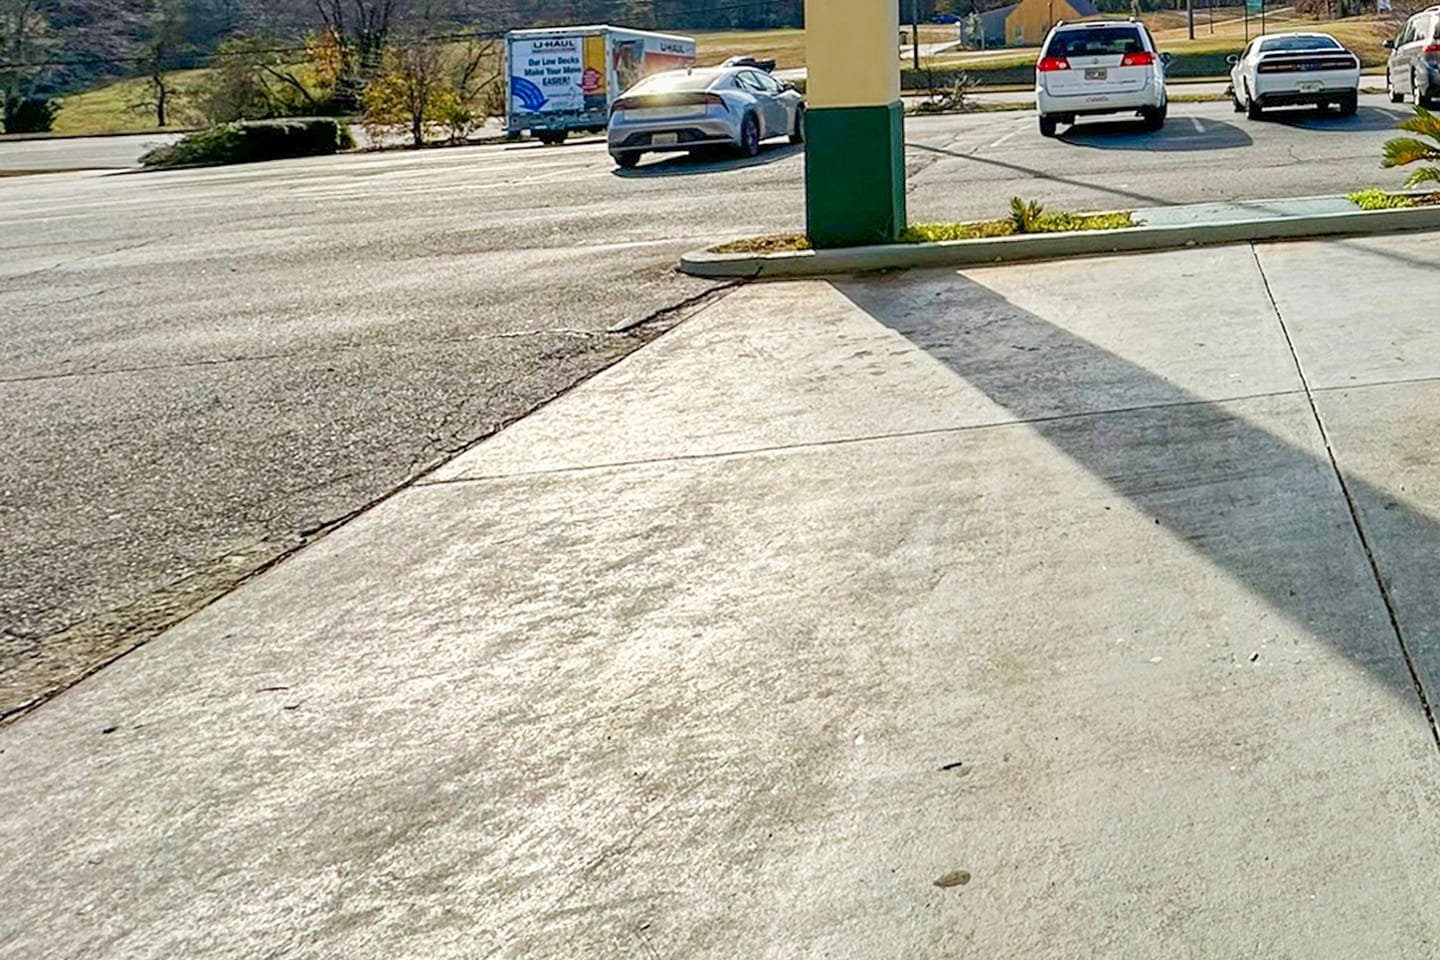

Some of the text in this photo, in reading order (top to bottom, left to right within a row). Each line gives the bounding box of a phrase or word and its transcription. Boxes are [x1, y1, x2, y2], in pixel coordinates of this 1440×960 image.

[528, 56, 579, 66] Our Low Decks
[524, 66, 581, 76] Make Your Move
